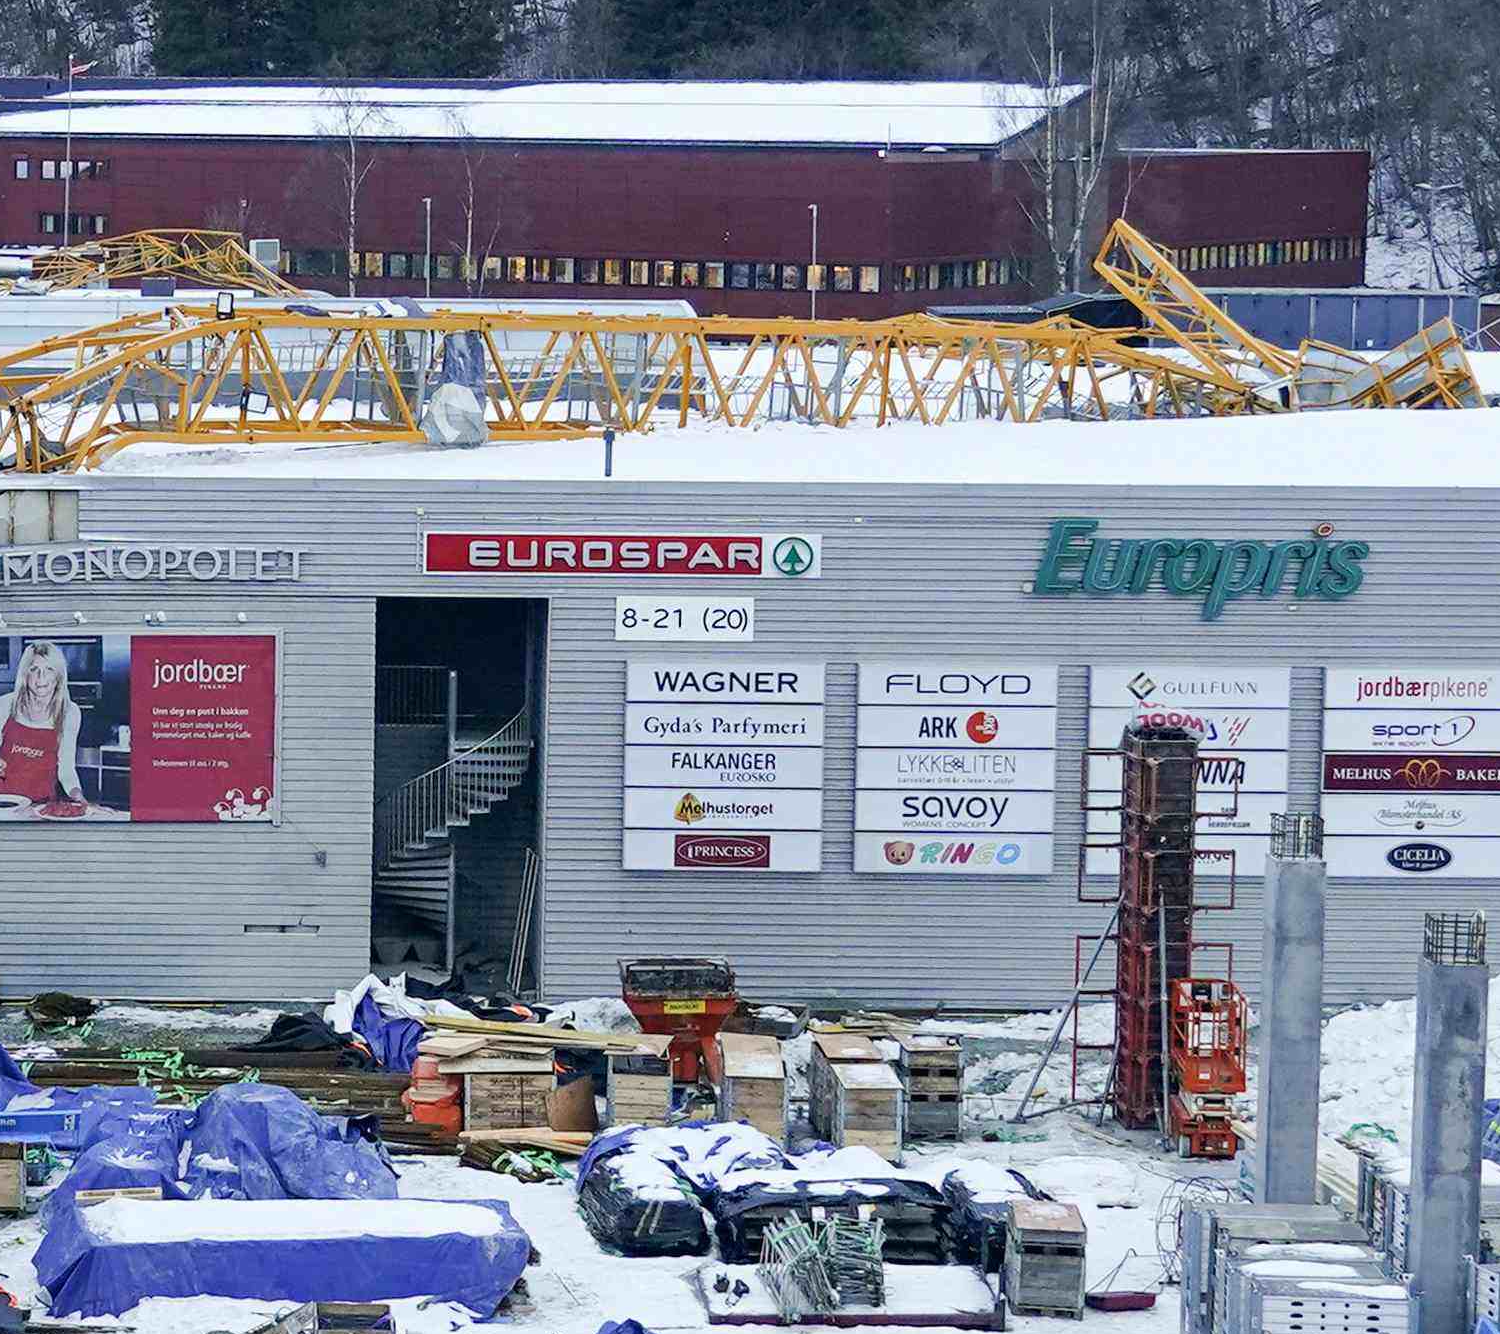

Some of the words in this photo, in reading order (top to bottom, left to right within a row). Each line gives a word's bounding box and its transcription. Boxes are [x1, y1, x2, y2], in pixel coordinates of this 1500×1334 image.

[468, 539, 760, 569] EUROSPAR
[1032, 516, 1371, 622] Europris
[621, 607, 685, 630] 8-21
[702, 606, 749, 633] (20)
[152, 658, 247, 689] jordbær
[654, 671, 799, 693] WAGNER
[886, 674, 1031, 694] FLOYD
[1162, 681, 1258, 695] GULLFUNN
[1356, 676, 1489, 702] jordbærpikene
[711, 717, 807, 739] Parfymeri
[918, 716, 958, 739] ARK
[1371, 723, 1441, 739] sport
[671, 752, 777, 771] FALKANGER
[719, 772, 777, 783] EUROSKO
[1332, 767, 1392, 781] MELHUS
[679, 800, 774, 817] Melhustorget
[902, 796, 1009, 828] savoy
[695, 846, 756, 858] PRINCESS
[919, 841, 1022, 865] RINGO
[1393, 849, 1446, 862] CICELIA
